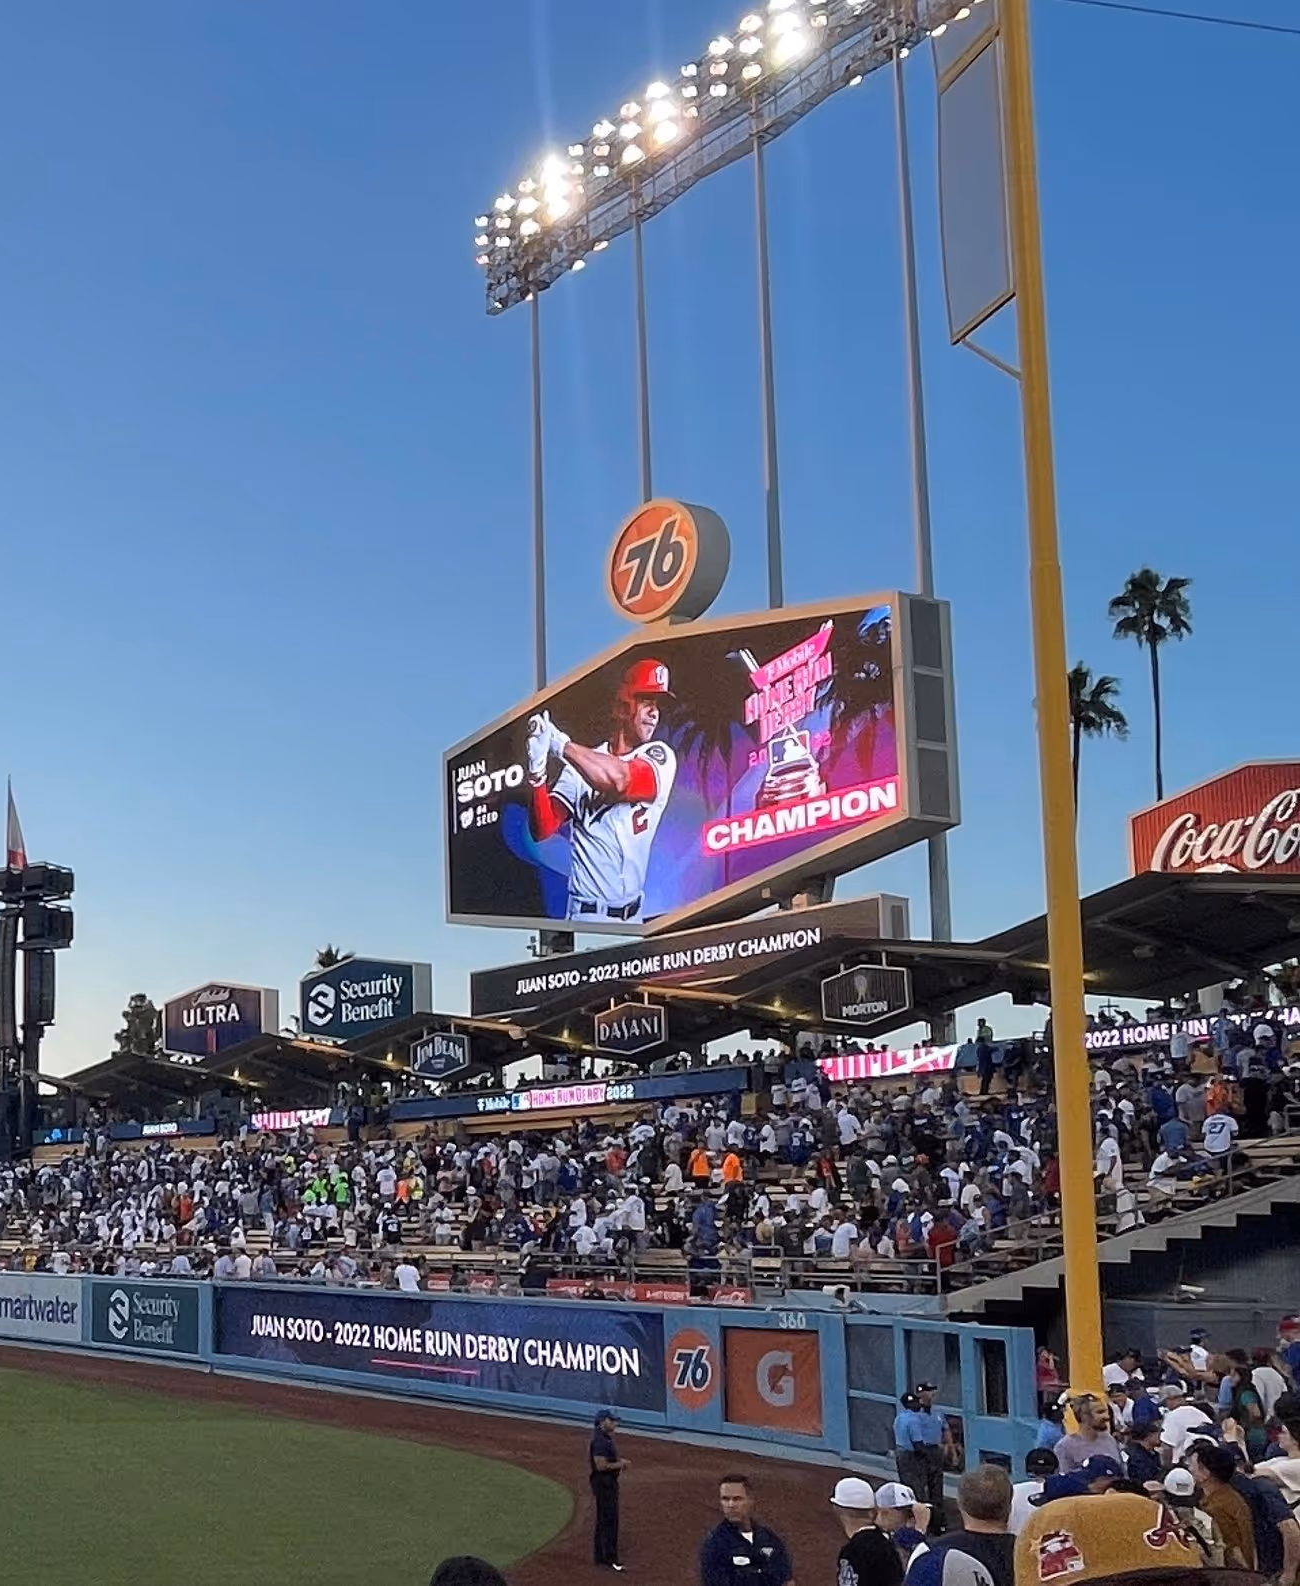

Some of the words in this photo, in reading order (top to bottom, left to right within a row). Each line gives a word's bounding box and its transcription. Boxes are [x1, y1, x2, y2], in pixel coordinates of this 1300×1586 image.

[619, 512, 687, 605] 76
[457, 760, 485, 782] JUAN
[457, 764, 524, 803] SOTO
[706, 782, 896, 850] CHAMPION
[516, 976, 547, 995] JUAN
[548, 970, 580, 989] SOTO
[589, 964, 619, 983] 2022
[621, 955, 660, 976] HOME
[663, 950, 691, 969] RUN
[694, 943, 736, 965] DERBY
[738, 927, 820, 957] CHAMPION
[340, 973, 403, 1000] Security
[182, 1003, 240, 1027] ULTRA
[341, 997, 394, 1022] Benefit
[842, 1001, 888, 1017] MORTON
[600, 1015, 658, 1041] DASANI
[1085, 1031, 1120, 1048] 2022
[1122, 1024, 1169, 1044] HOME
[434, 1036, 463, 1064] BEAM
[606, 1083, 635, 1100] 2022
[132, 1291, 180, 1322] Security
[778, 1311, 806, 1329] 360
[133, 1318, 175, 1344] Benefit
[251, 1315, 285, 1338] JUAN
[286, 1317, 324, 1343] SOTO
[334, 1321, 371, 1347] 2022
[373, 1325, 422, 1353] HOME
[425, 1330, 461, 1360] RUN
[465, 1333, 520, 1363] DERBY
[524, 1338, 640, 1376] CHAMPION
[673, 1346, 712, 1392] 76
[756, 1350, 795, 1407] G
